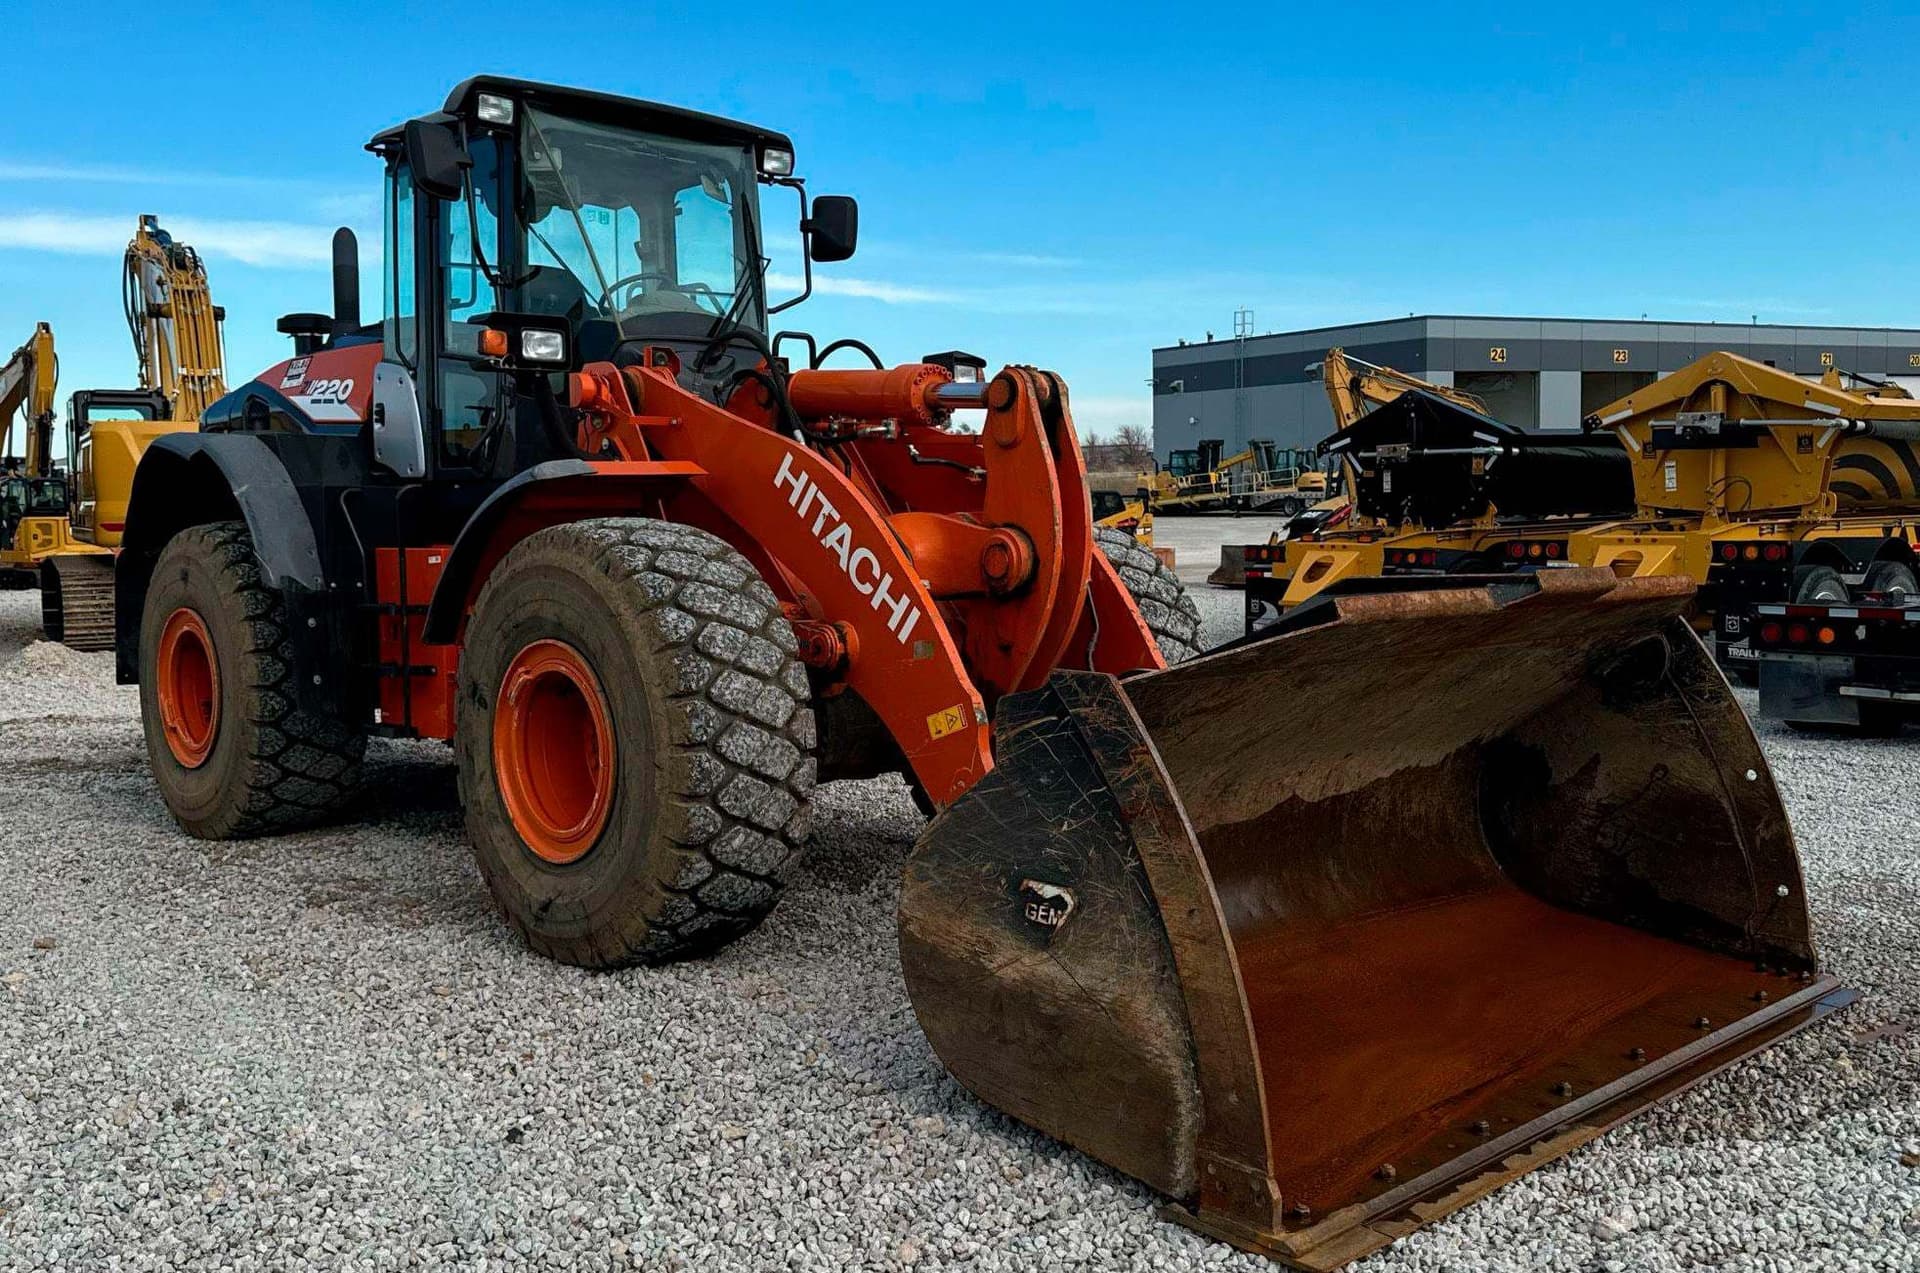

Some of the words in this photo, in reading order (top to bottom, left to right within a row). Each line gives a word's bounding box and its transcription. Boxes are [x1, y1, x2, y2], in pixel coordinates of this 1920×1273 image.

[1490, 348, 1506, 361] 24
[1614, 350, 1628, 362] 23
[1822, 354, 1832, 365] 21
[773, 451, 921, 645] HITACHI
